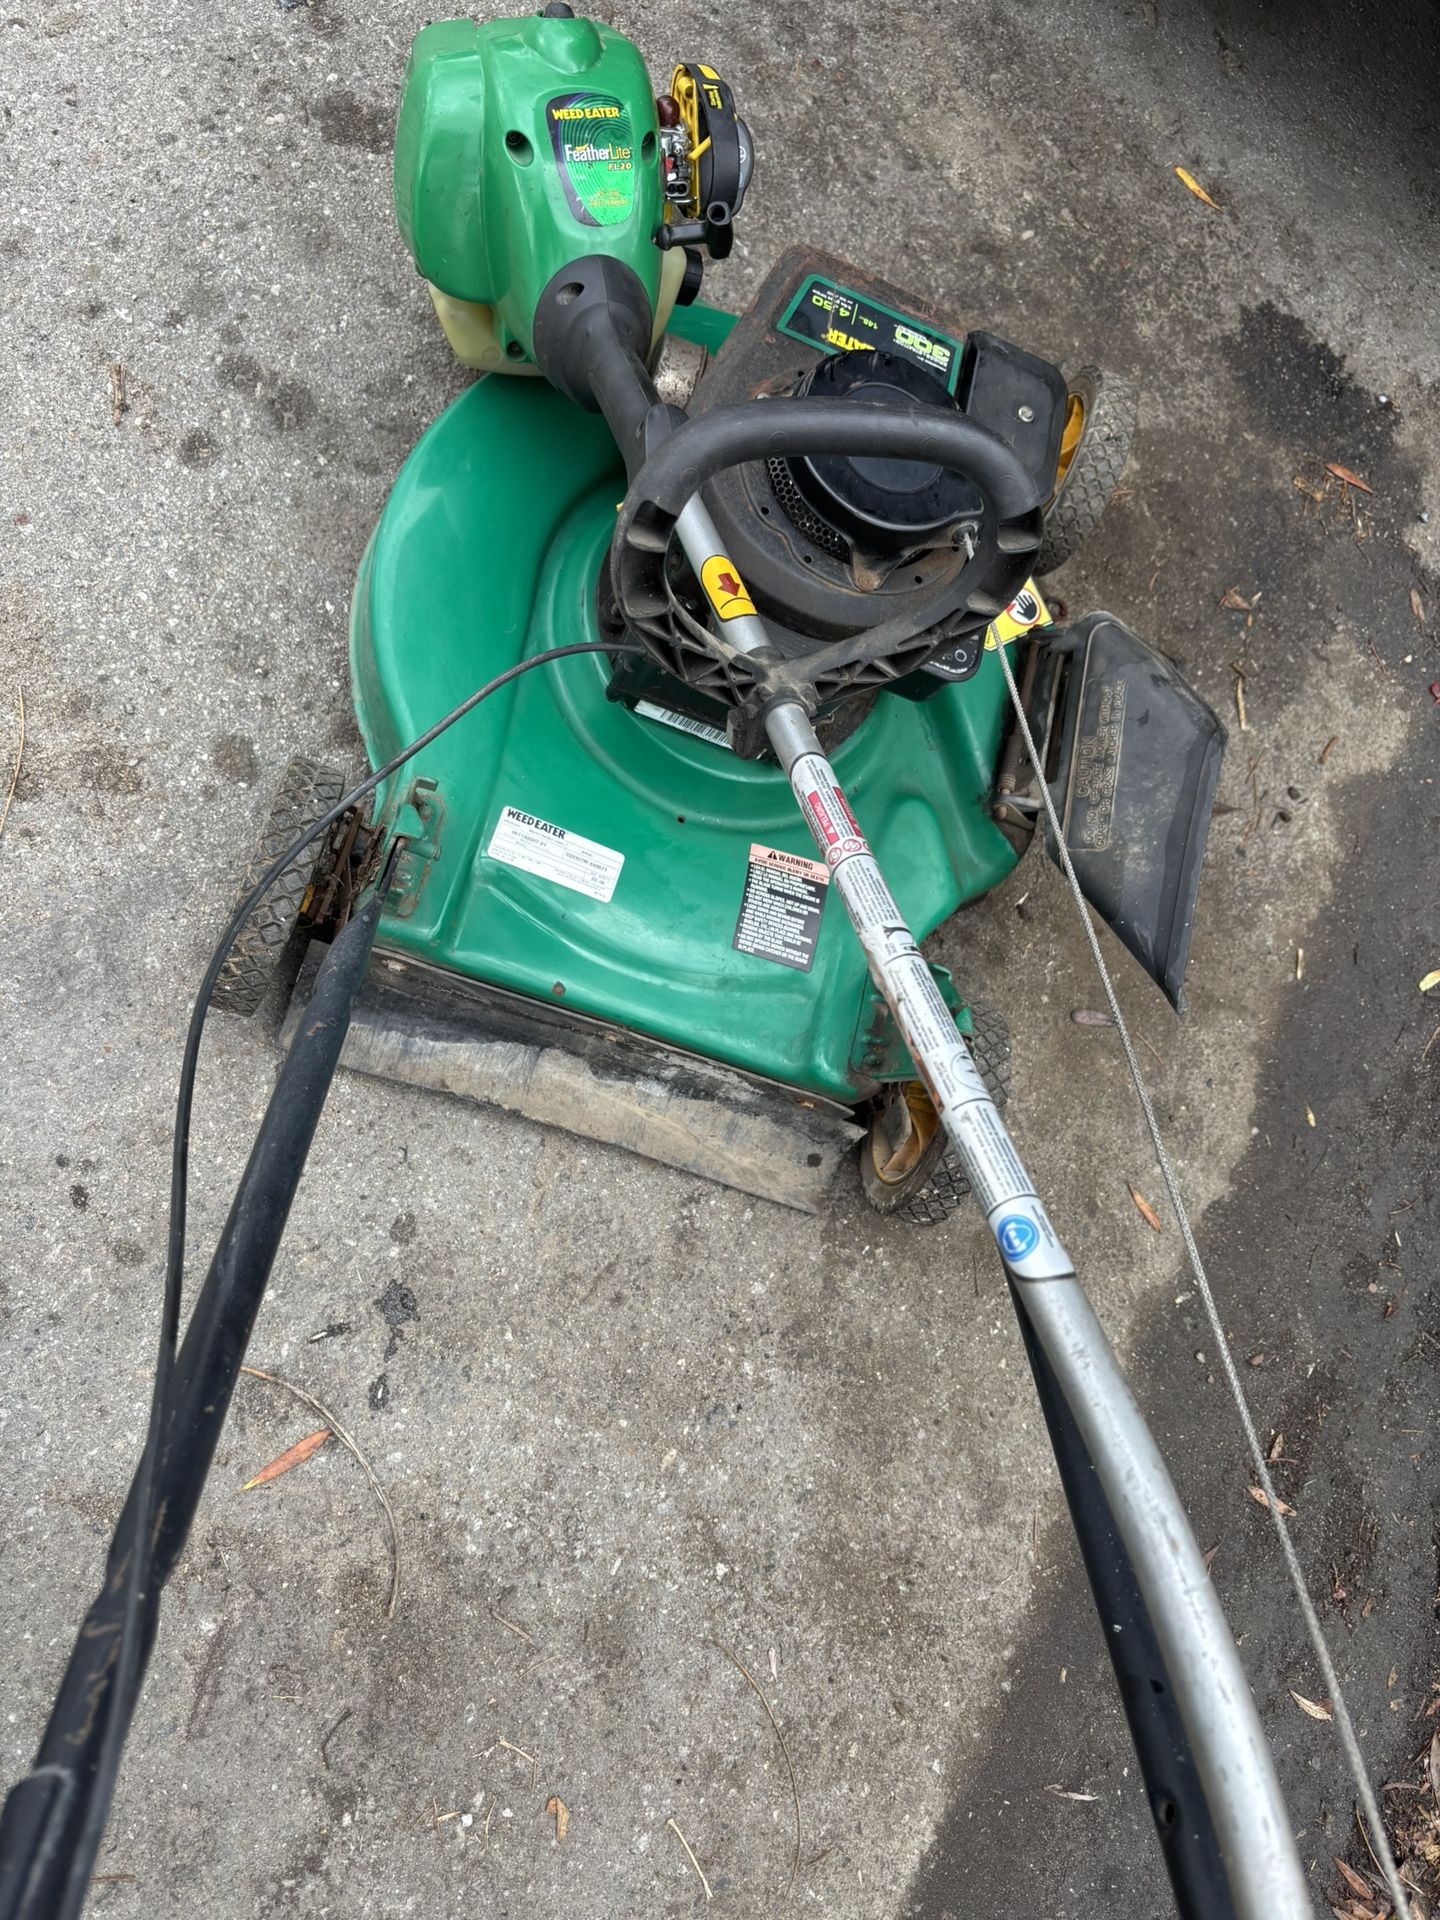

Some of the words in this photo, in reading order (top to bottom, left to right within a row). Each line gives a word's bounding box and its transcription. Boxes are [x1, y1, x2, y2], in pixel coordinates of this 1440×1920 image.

[552, 108, 584, 120] WEED
[585, 107, 621, 118] EATER
[565, 143, 632, 163] FeatherLite
[812, 295, 850, 317] 4.50
[894, 326, 951, 362] 300
[1076, 735, 1093, 797] CAUTION
[507, 808, 535, 826] WEED
[535, 820, 566, 839] EATER
[779, 854, 813, 870] WARNING
